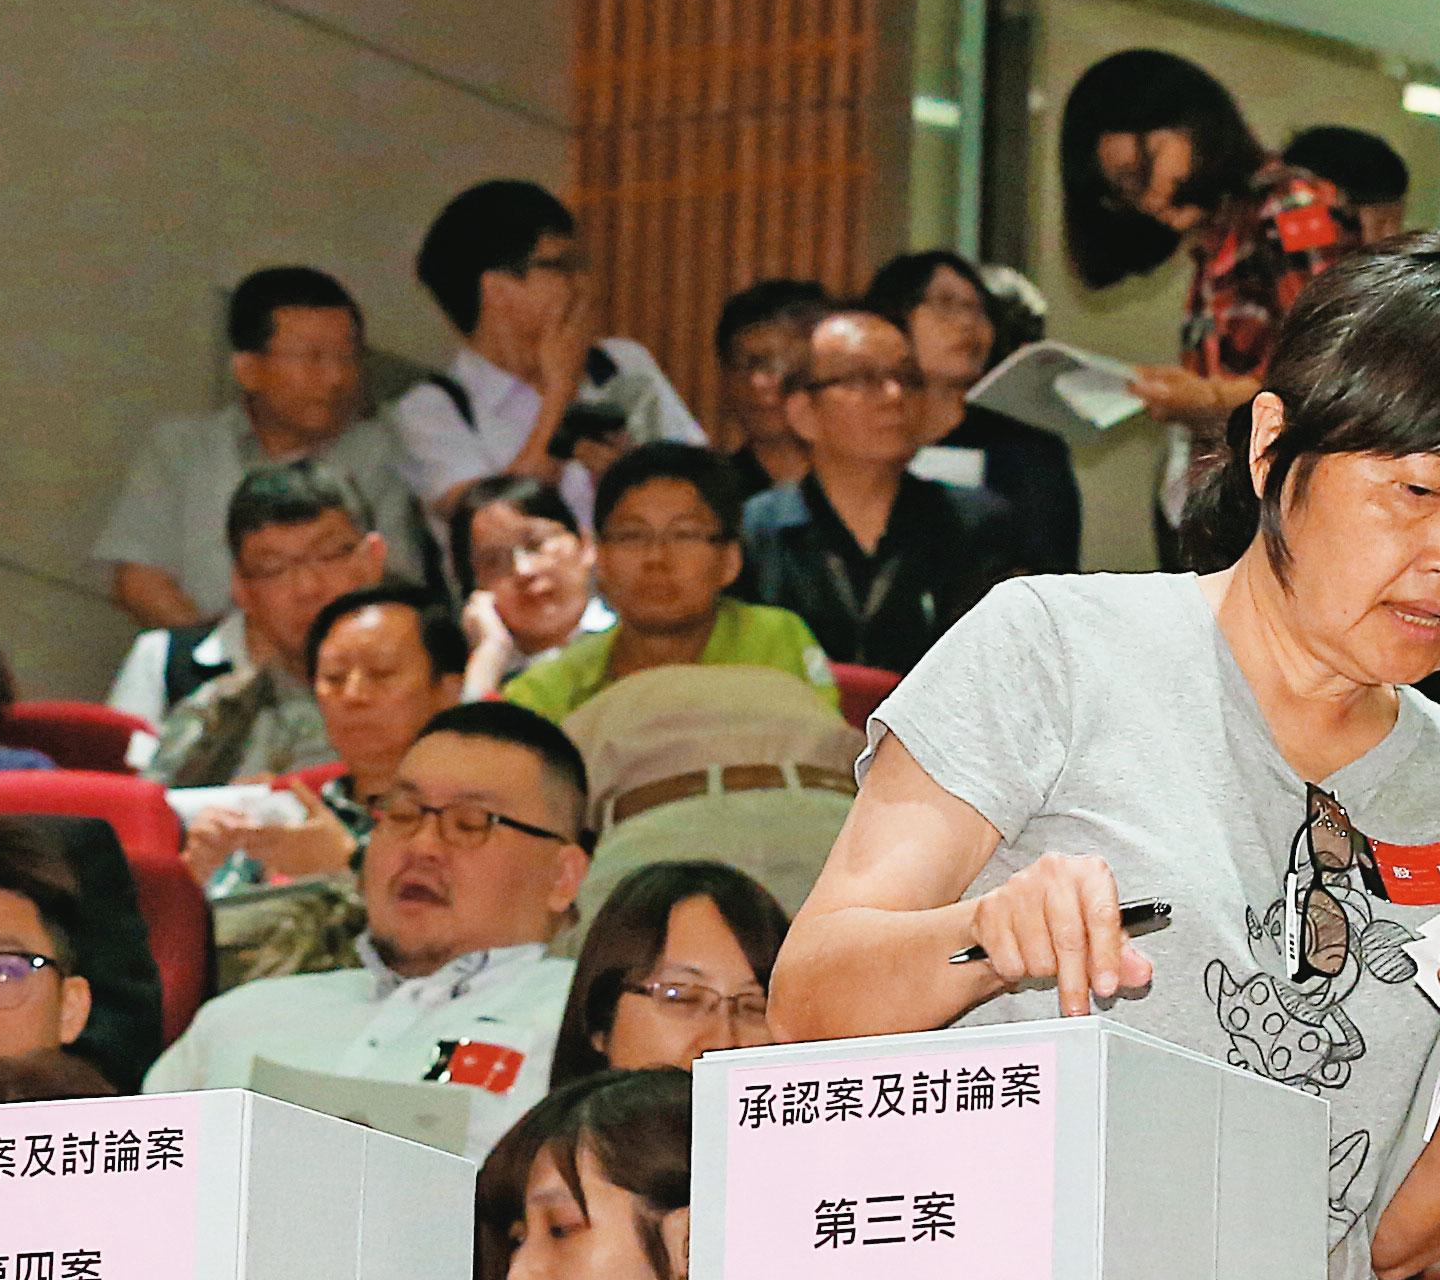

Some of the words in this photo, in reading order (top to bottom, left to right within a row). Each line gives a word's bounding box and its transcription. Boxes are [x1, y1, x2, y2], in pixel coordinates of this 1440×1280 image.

[738, 1062, 1042, 1130] 承認案及討論案
[812, 1191, 957, 1250] 第三案
